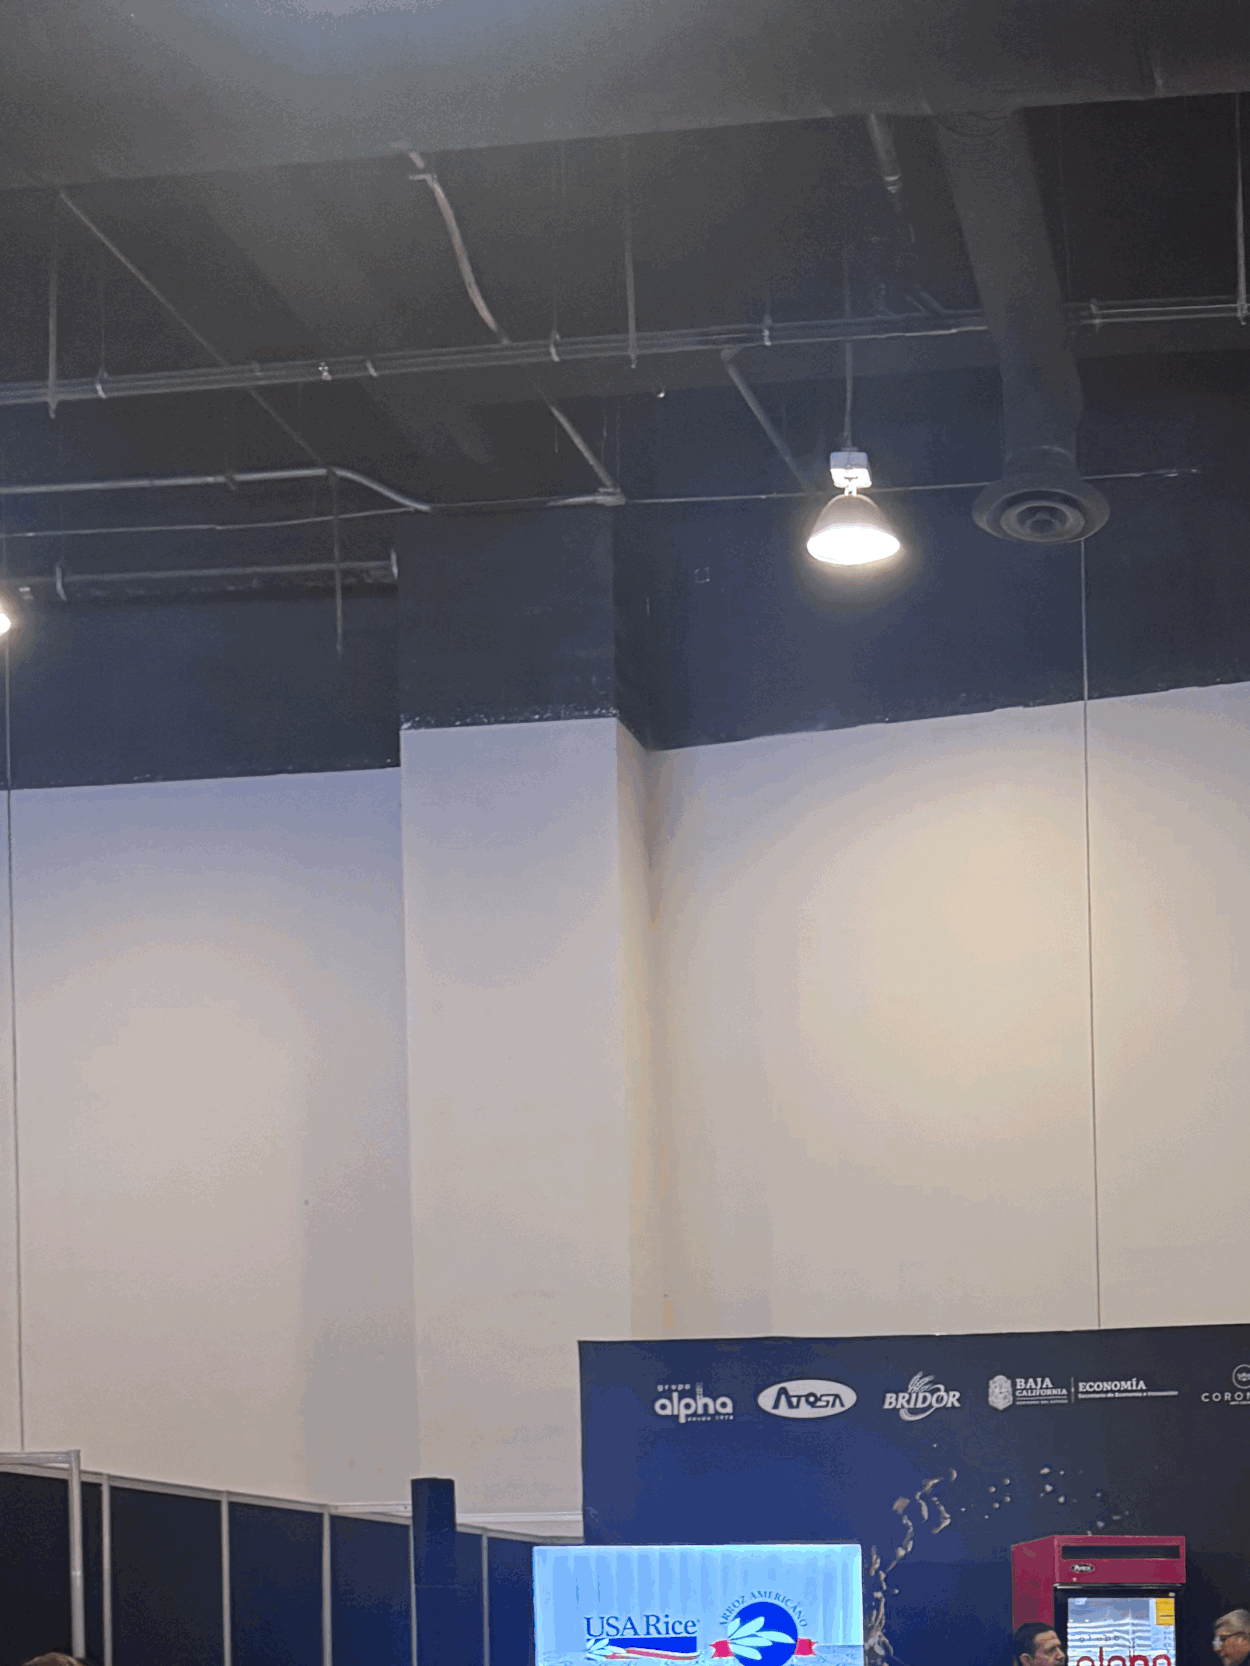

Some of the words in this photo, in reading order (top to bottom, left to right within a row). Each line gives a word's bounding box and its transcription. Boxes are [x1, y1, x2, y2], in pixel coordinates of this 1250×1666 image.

[1015, 1377, 1053, 1390] BAJA
[1078, 1378, 1147, 1392] ECONOMÍA
[883, 1391, 962, 1409] BRIDOR
[1015, 1388, 1068, 1397] CALIFORNIA
[654, 1383, 734, 1423] alpha
[584, 1615, 638, 1638] USA
[642, 1614, 697, 1636] Rice
